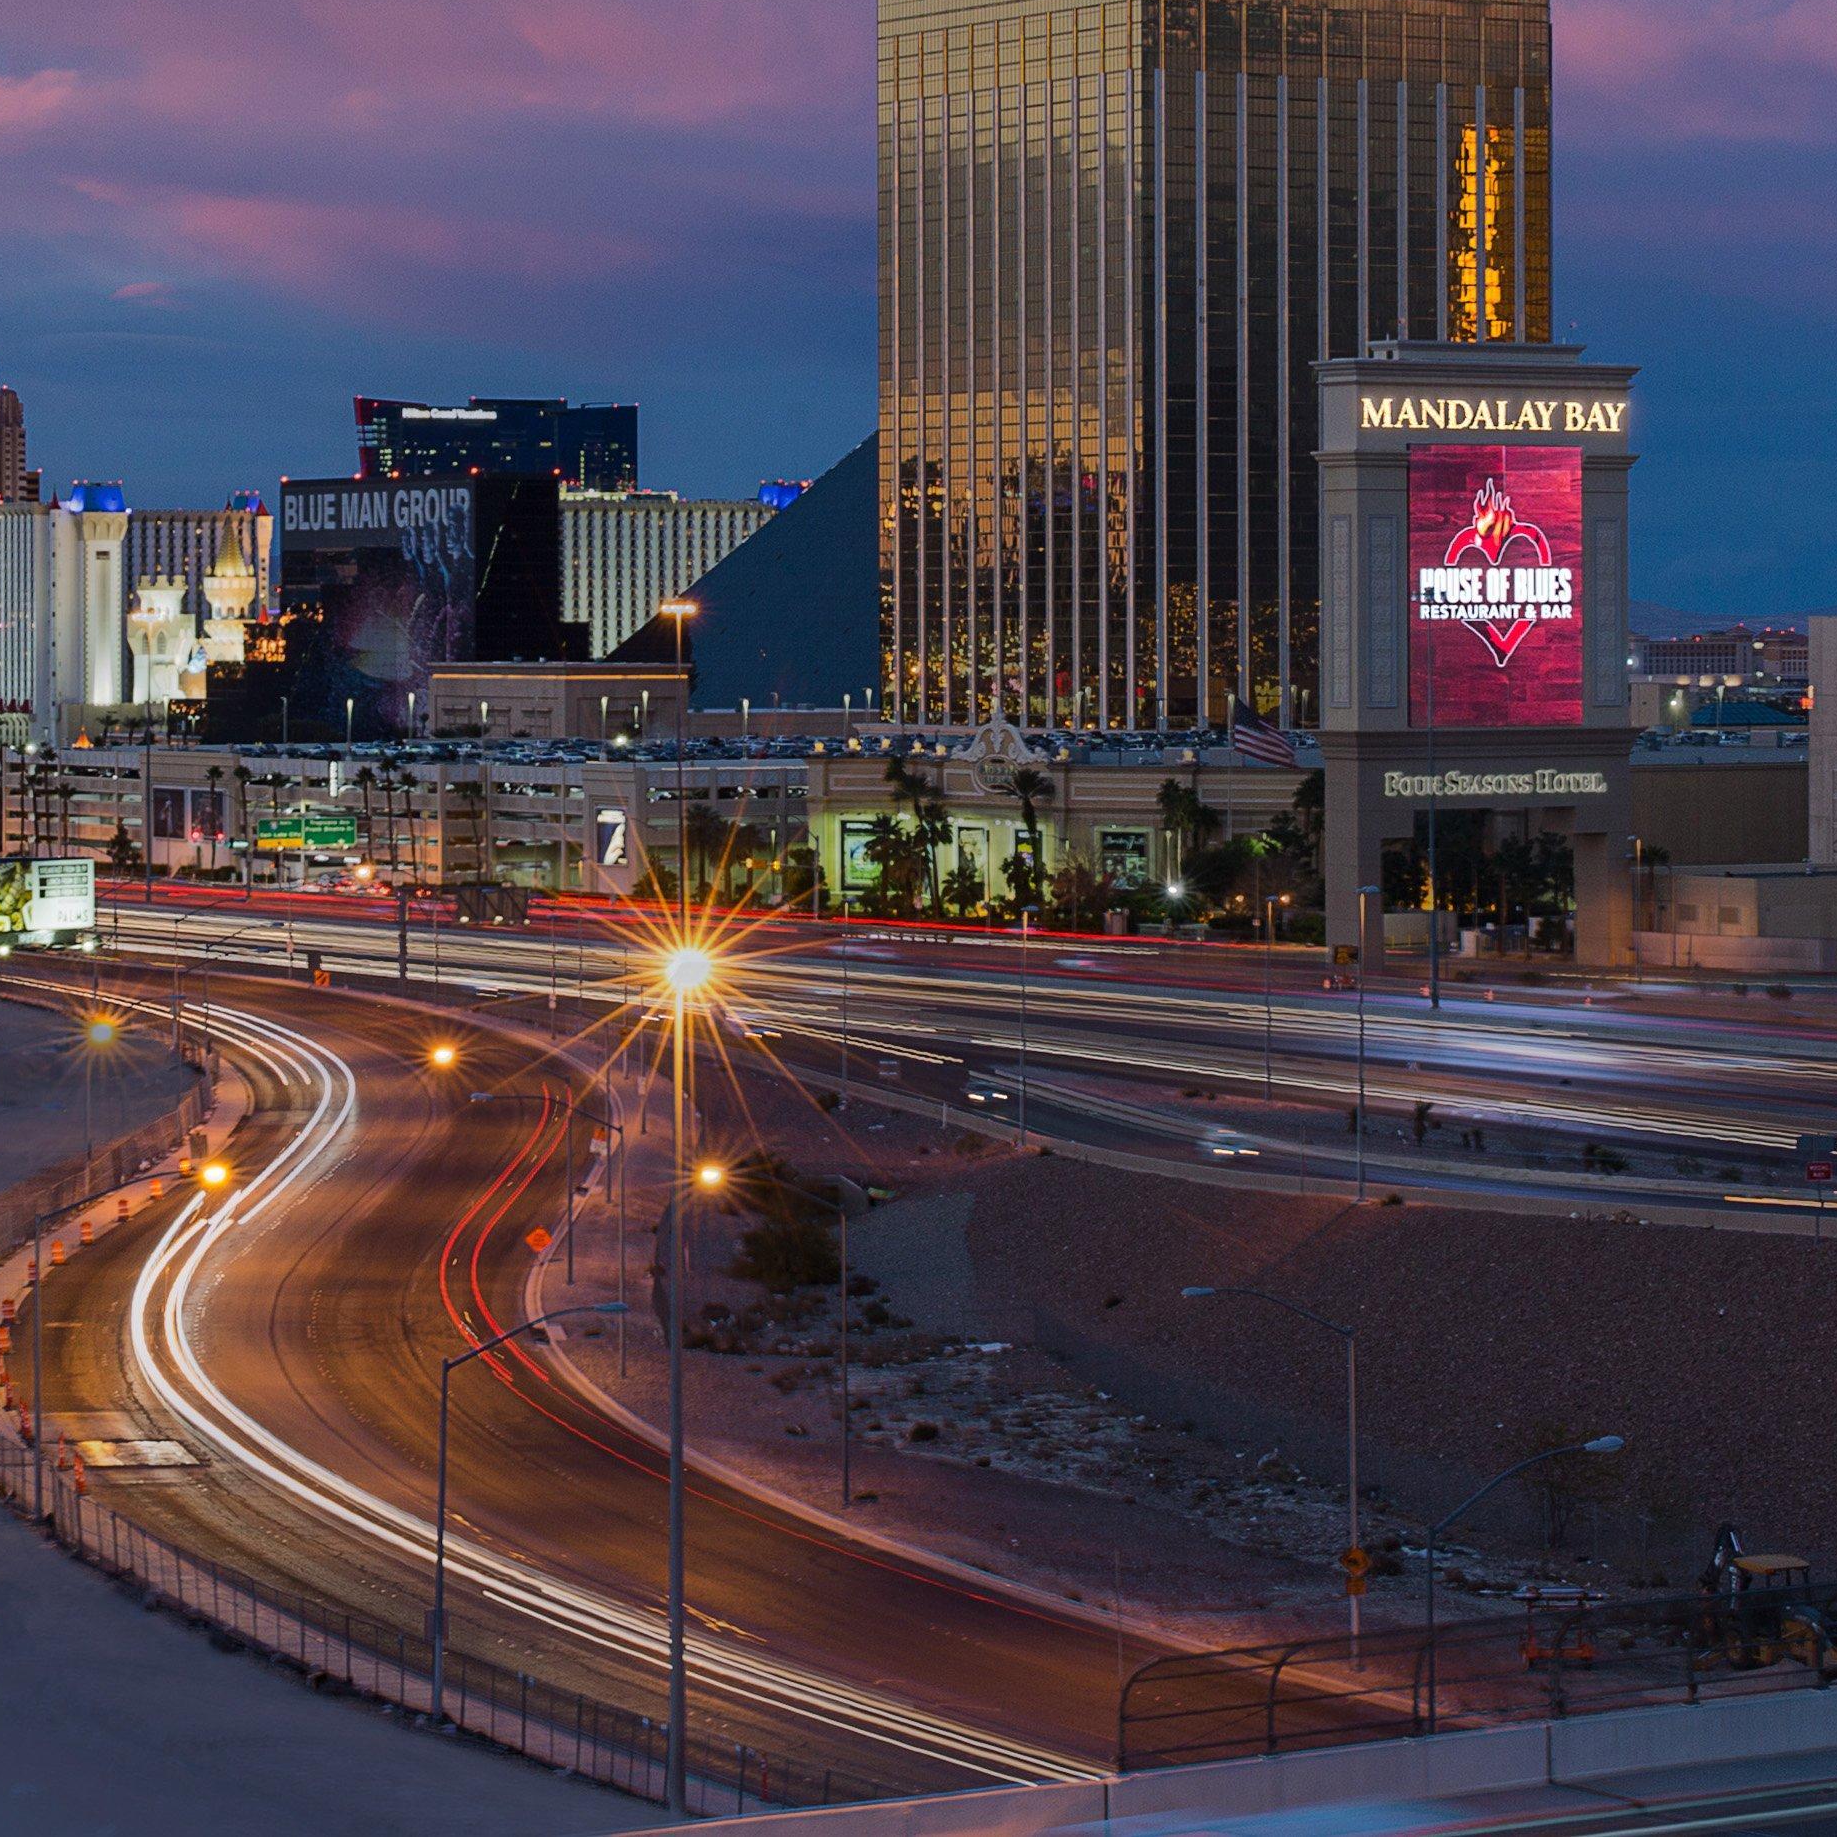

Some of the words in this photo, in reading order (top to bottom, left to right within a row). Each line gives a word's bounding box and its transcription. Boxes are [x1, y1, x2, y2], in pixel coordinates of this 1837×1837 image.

[1361, 397, 1558, 431] MANDALAY
[1564, 401, 1626, 432] BAY
[284, 494, 336, 530] BLUE
[341, 491, 388, 529] MAN
[393, 488, 470, 528] GROUP
[1419, 567, 1483, 603] HOUSE
[1486, 567, 1510, 603] OF
[1514, 567, 1573, 603] BLUES
[1420, 605, 1522, 619] RESTAURANT
[1524, 605, 1537, 619] &
[1541, 605, 1573, 619] BAR
